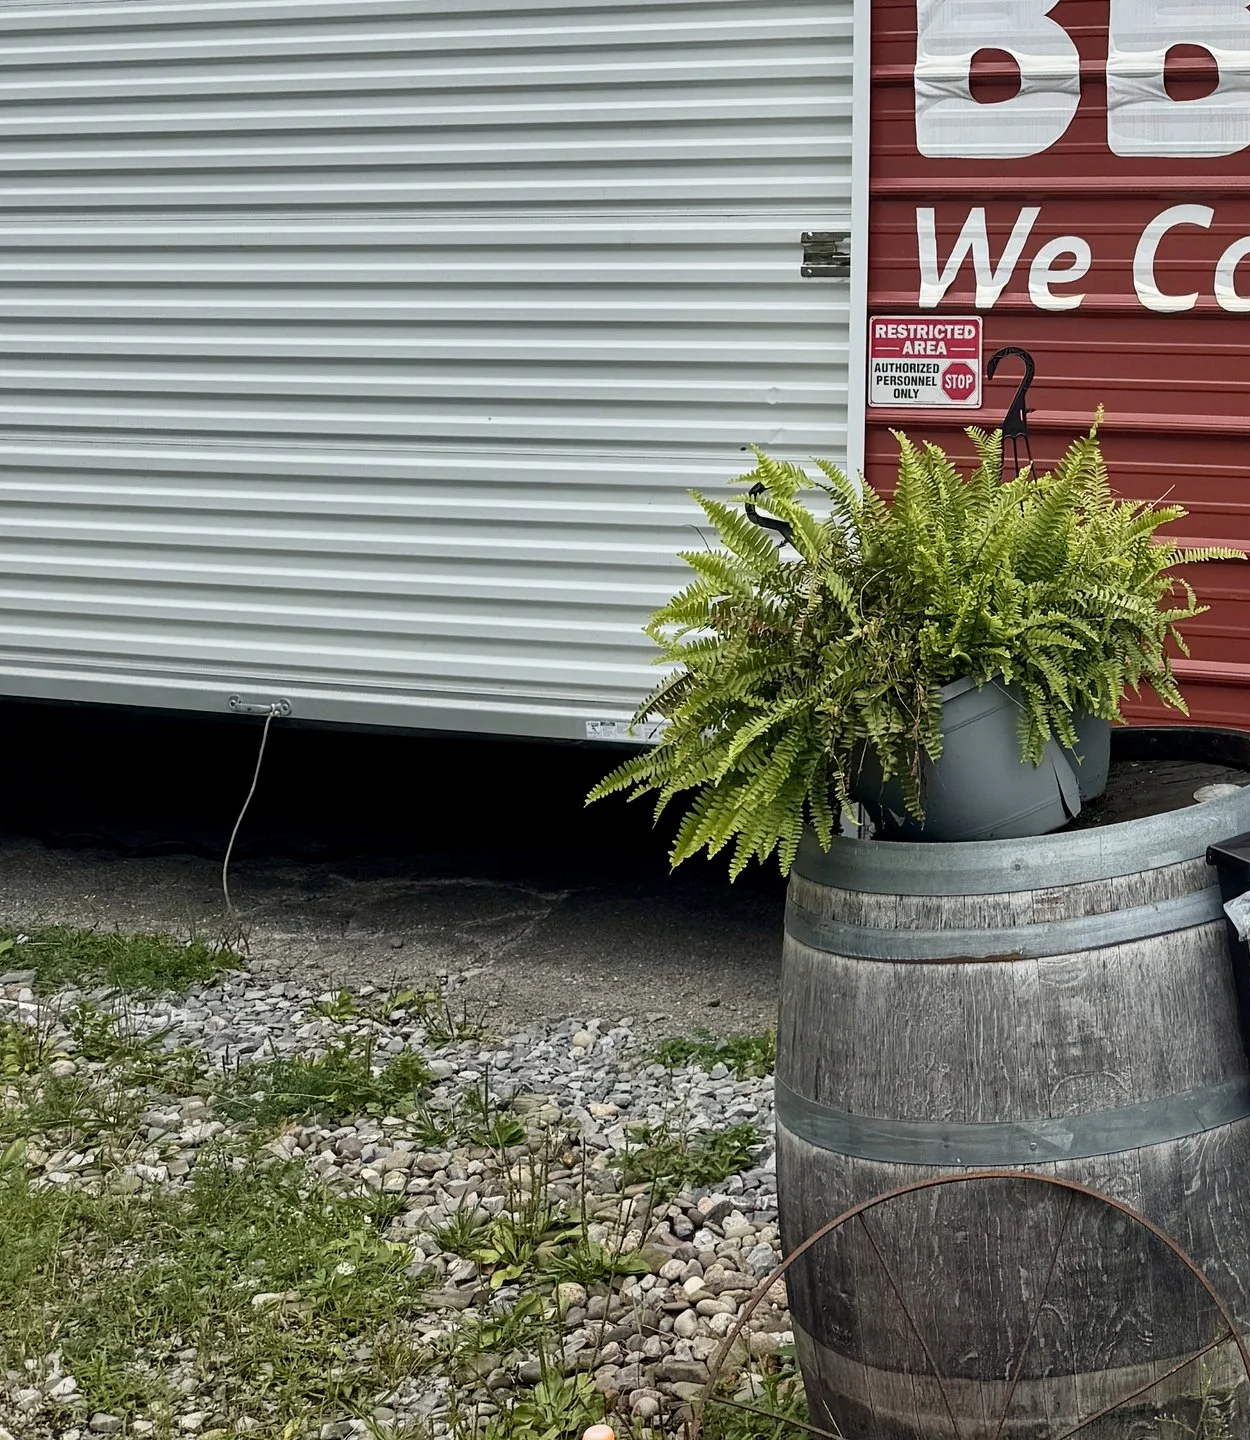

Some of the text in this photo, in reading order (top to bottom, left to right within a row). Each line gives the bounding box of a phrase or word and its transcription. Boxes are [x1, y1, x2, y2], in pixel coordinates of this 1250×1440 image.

[914, 205, 1093, 312] We
[874, 323, 976, 340] RESTRICTED
[901, 340, 948, 356] AREA
[874, 362, 940, 375] AUTHORIZED
[876, 375, 938, 387] PERSONNEL
[944, 374, 974, 390] STOP
[893, 388, 920, 400] ONLY
